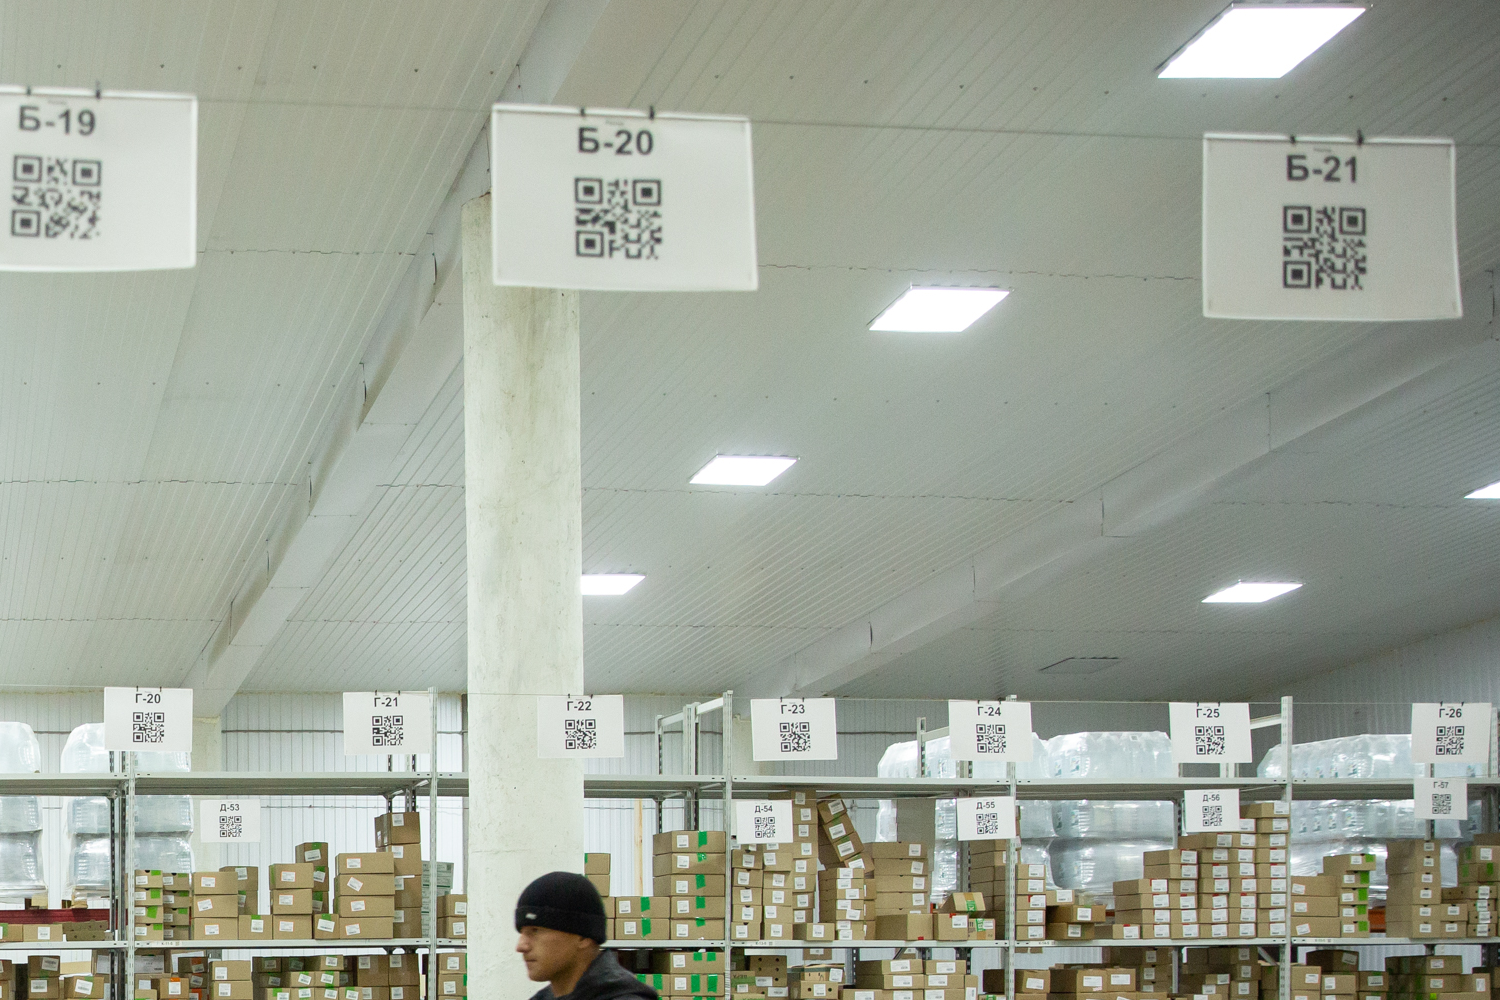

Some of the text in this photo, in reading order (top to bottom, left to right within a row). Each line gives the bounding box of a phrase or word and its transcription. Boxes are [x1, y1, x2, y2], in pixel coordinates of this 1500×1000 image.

[18, 105, 97, 137] Б-19
[577, 127, 654, 156] Б-20
[1286, 155, 1358, 184] Б-21
[135, 693, 161, 704] Г-20
[374, 696, 399, 708] Г-21
[566, 700, 592, 712] Г-22
[780, 704, 806, 715] Г-23
[977, 706, 1002, 717] Г-24
[1196, 708, 1221, 719] Г-25
[1438, 708, 1463, 719] Г-26
[1202, 793, 1220, 803] Д-56
[219, 803, 240, 813] Д-53
[754, 804, 773, 814] Д-54
[975, 801, 996, 810] Д-55
